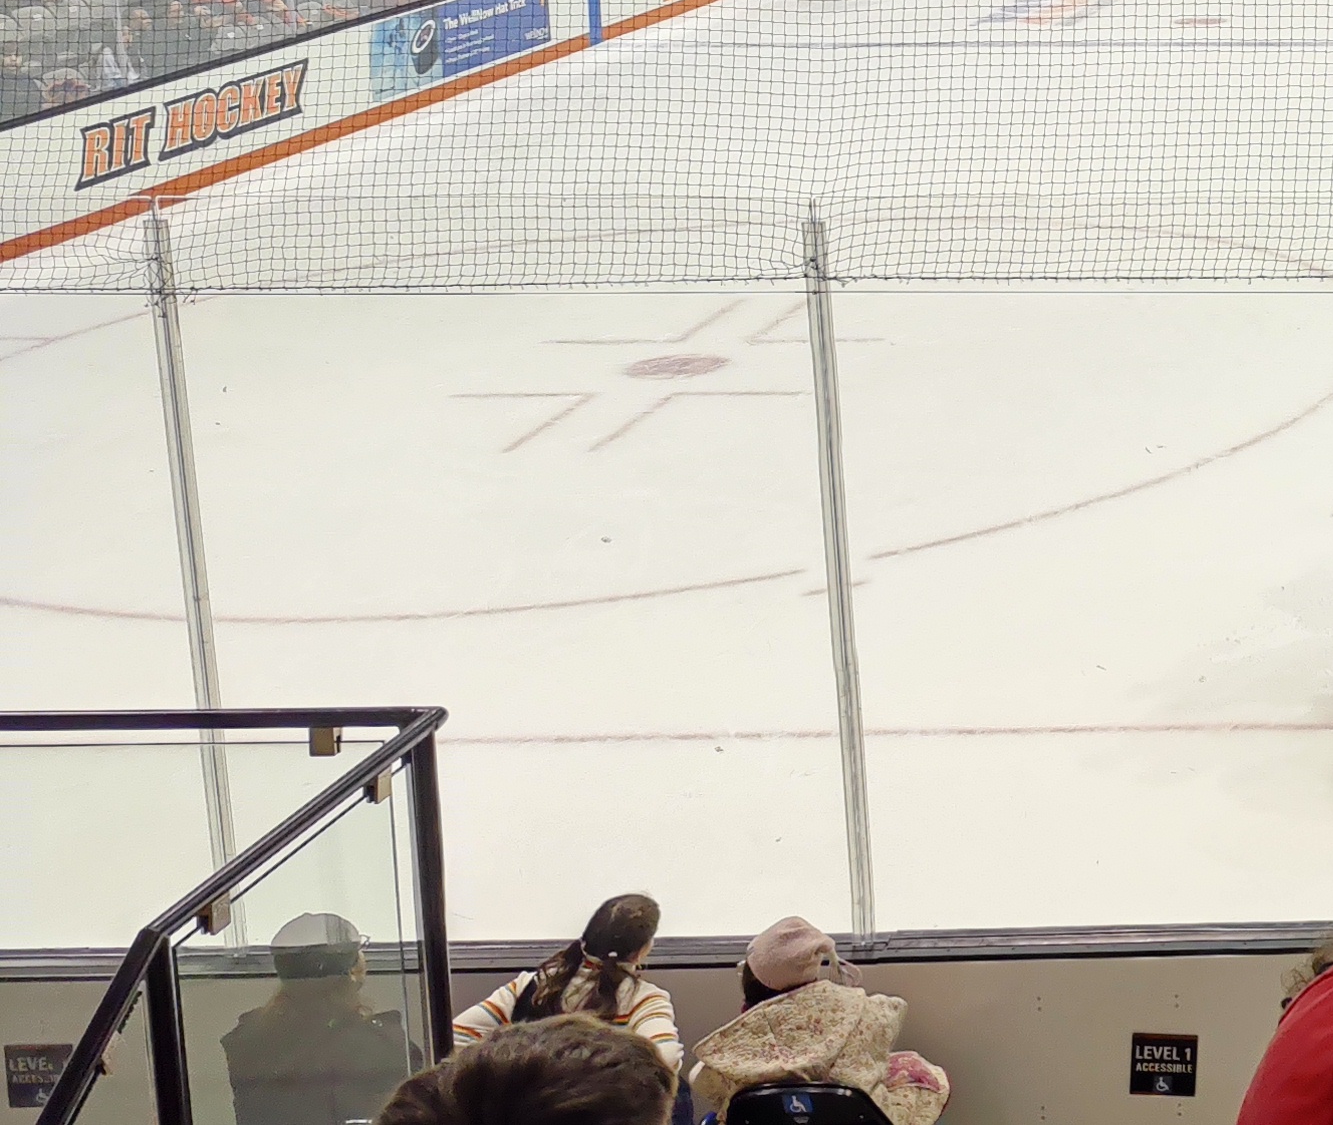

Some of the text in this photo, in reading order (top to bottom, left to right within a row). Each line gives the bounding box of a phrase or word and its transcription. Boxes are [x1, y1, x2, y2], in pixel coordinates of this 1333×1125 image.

[443, 16, 458, 30] The
[78, 61, 307, 187] RIT HOCKEY
[1135, 1045, 1191, 1062] LEVEL 1
[1136, 1062, 1193, 1074] ACCESSIBLE
